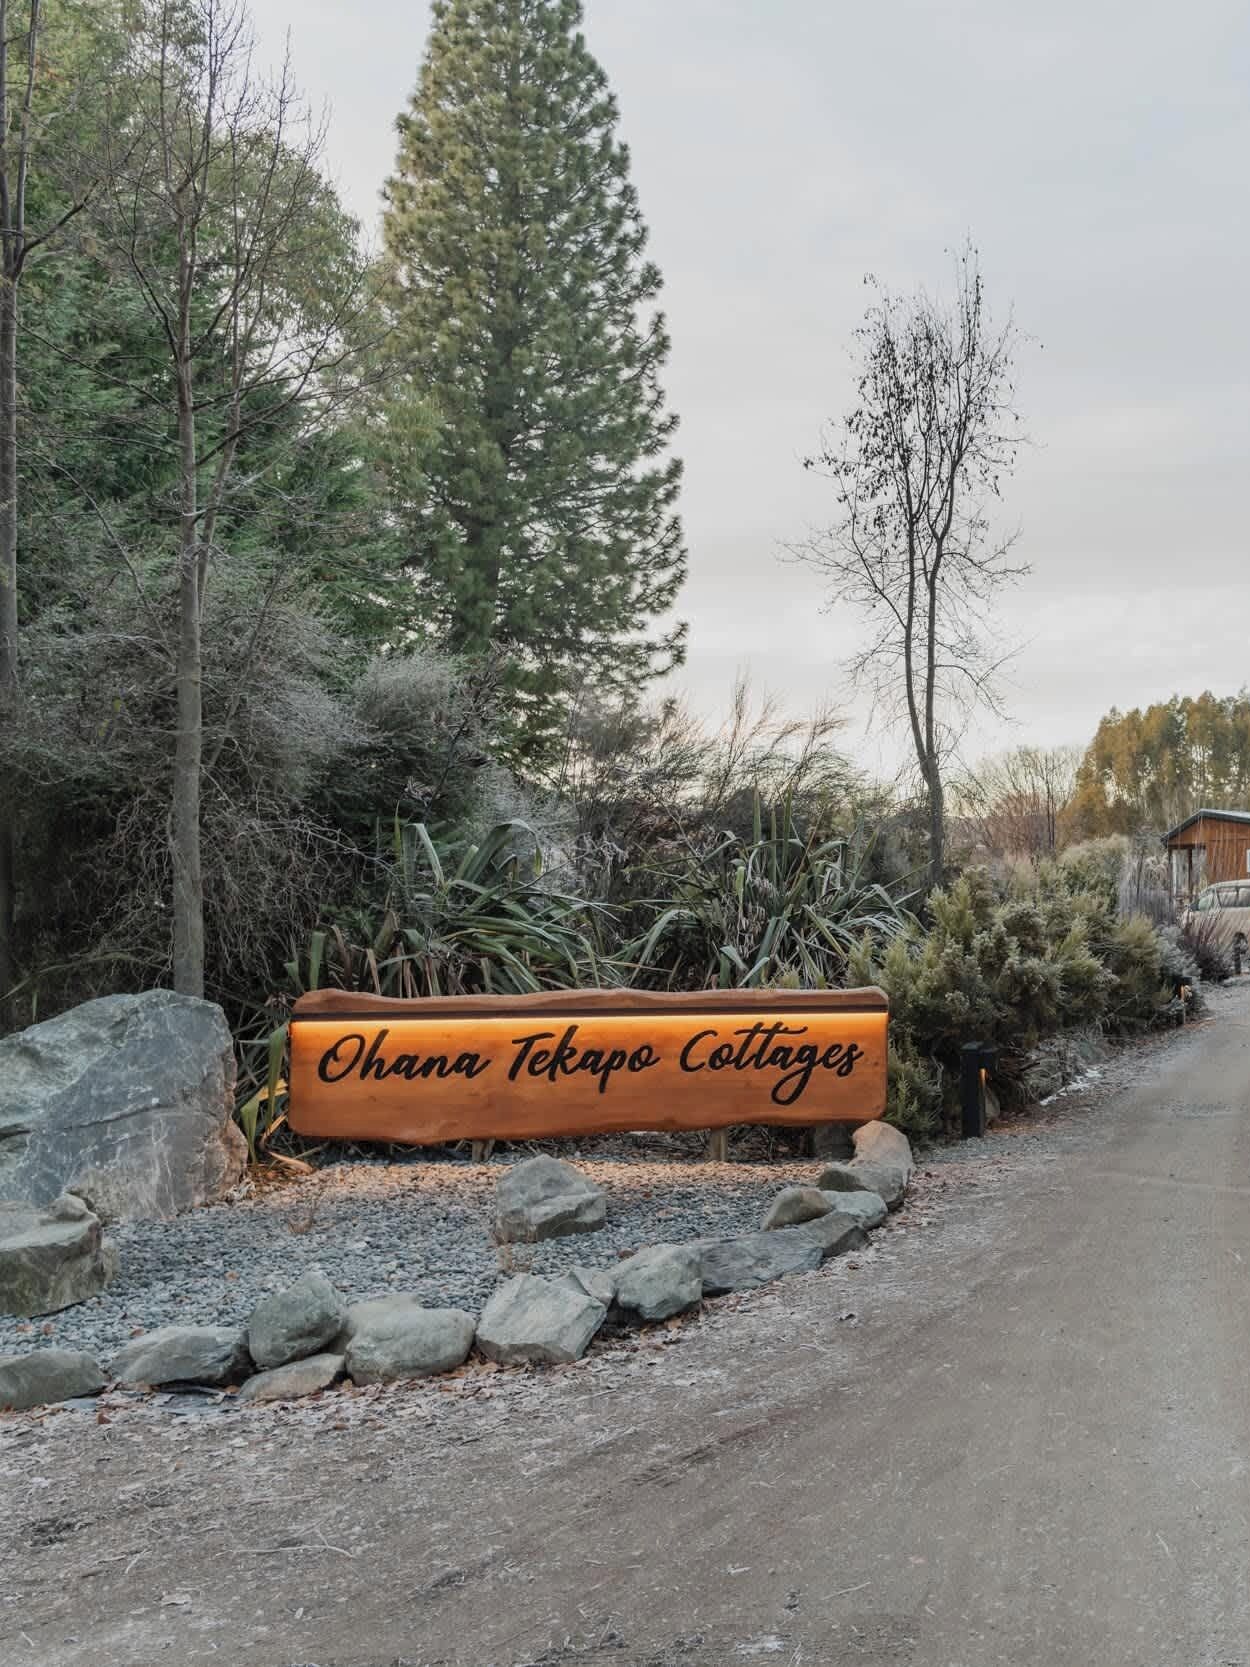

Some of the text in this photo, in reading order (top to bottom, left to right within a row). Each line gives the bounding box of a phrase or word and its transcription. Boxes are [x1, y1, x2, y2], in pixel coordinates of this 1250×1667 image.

[318, 1021, 865, 1106] Ohana Tekapo Cottages
